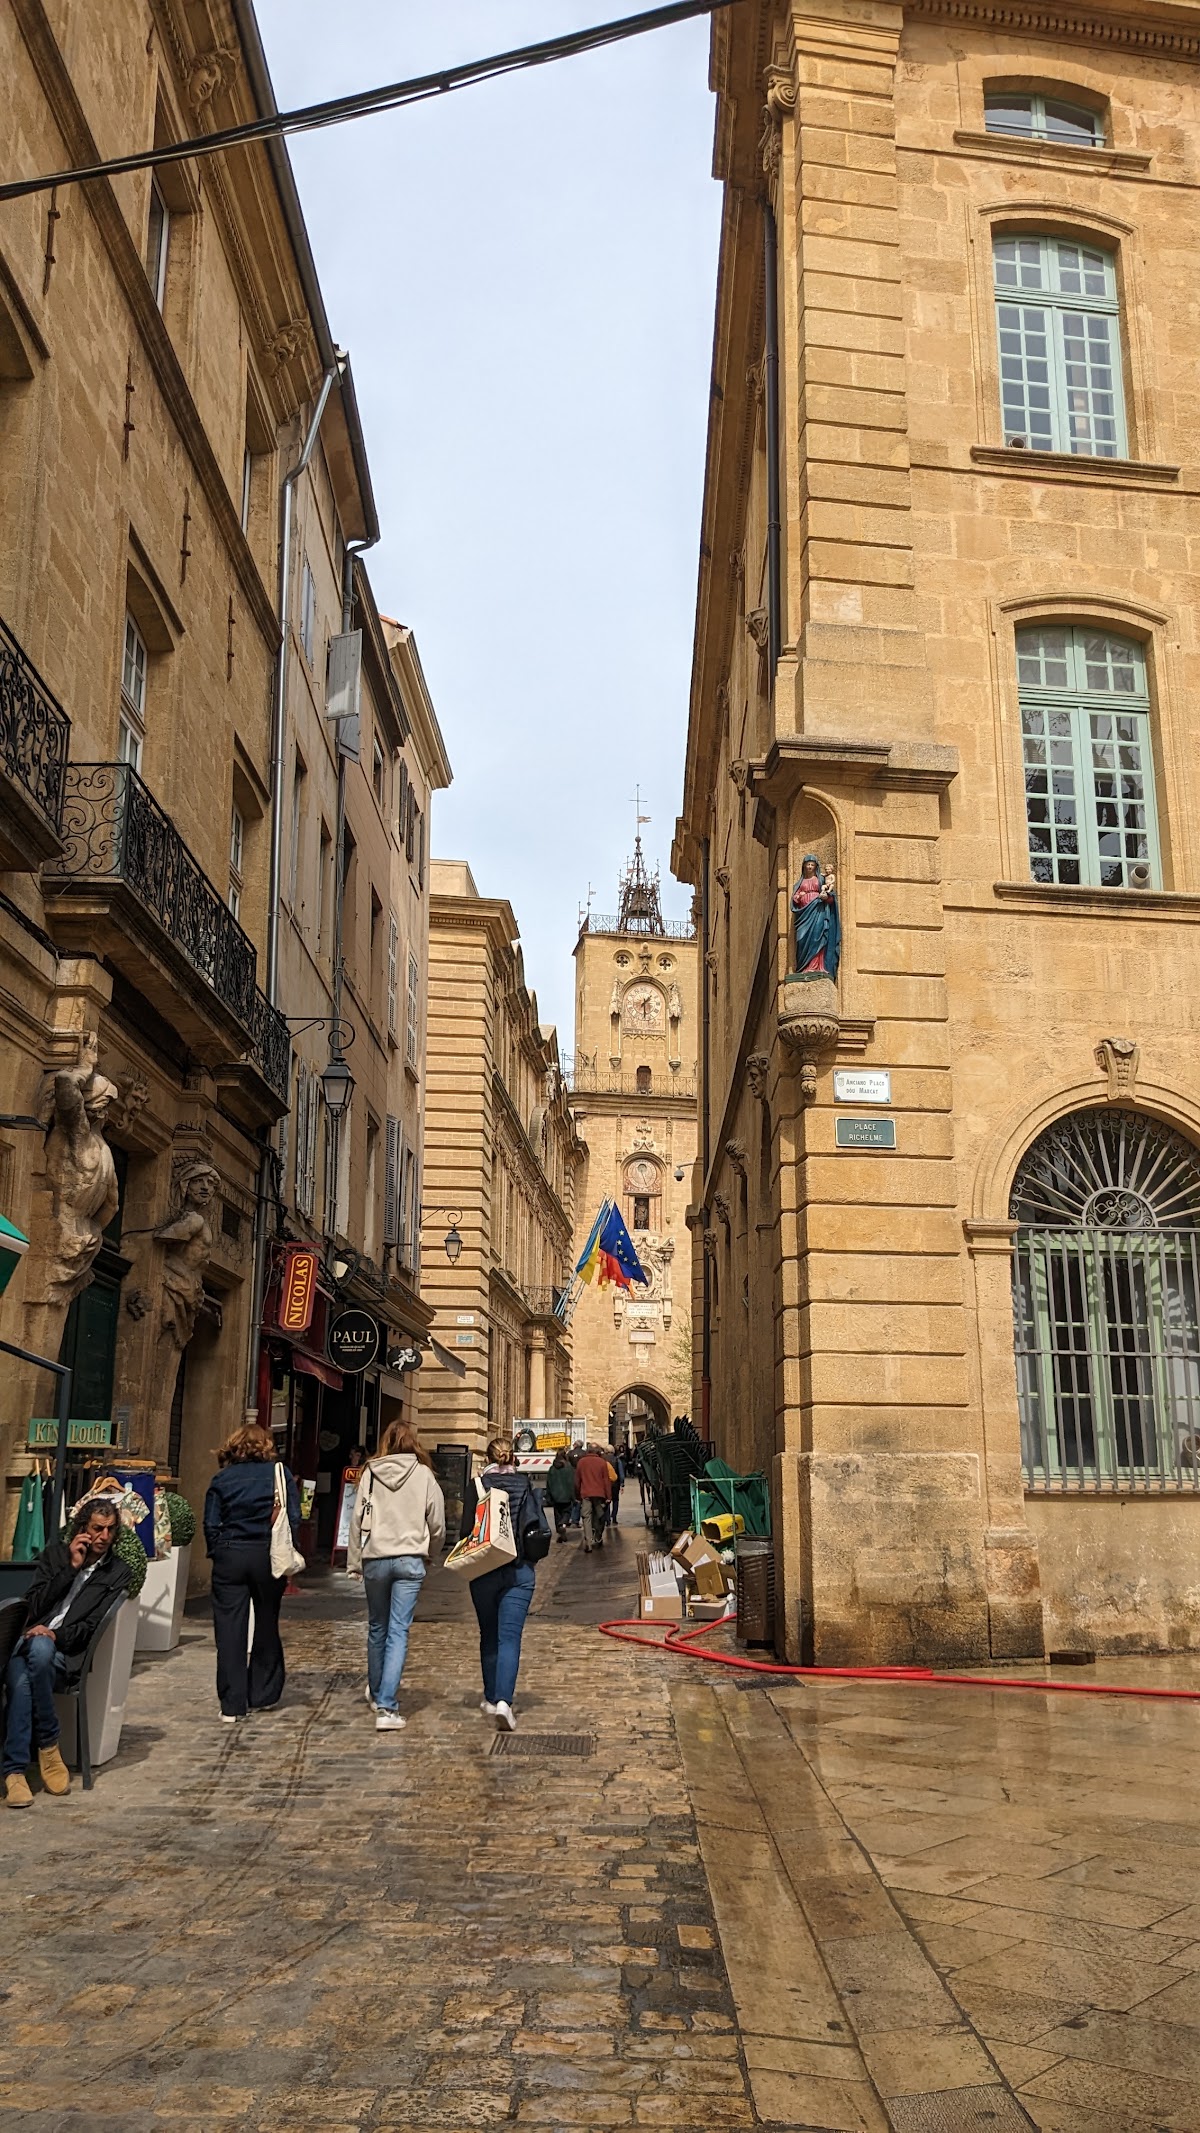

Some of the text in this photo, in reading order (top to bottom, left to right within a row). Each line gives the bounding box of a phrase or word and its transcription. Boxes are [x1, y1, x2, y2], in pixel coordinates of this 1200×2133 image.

[854, 1123, 877, 1131] PLACE
[848, 1133, 883, 1142] RICHELME
[288, 1259, 309, 1324] NICOLAS
[332, 1330, 375, 1343] PAUL
[35, 1422, 106, 1444] KIN LOUIE
